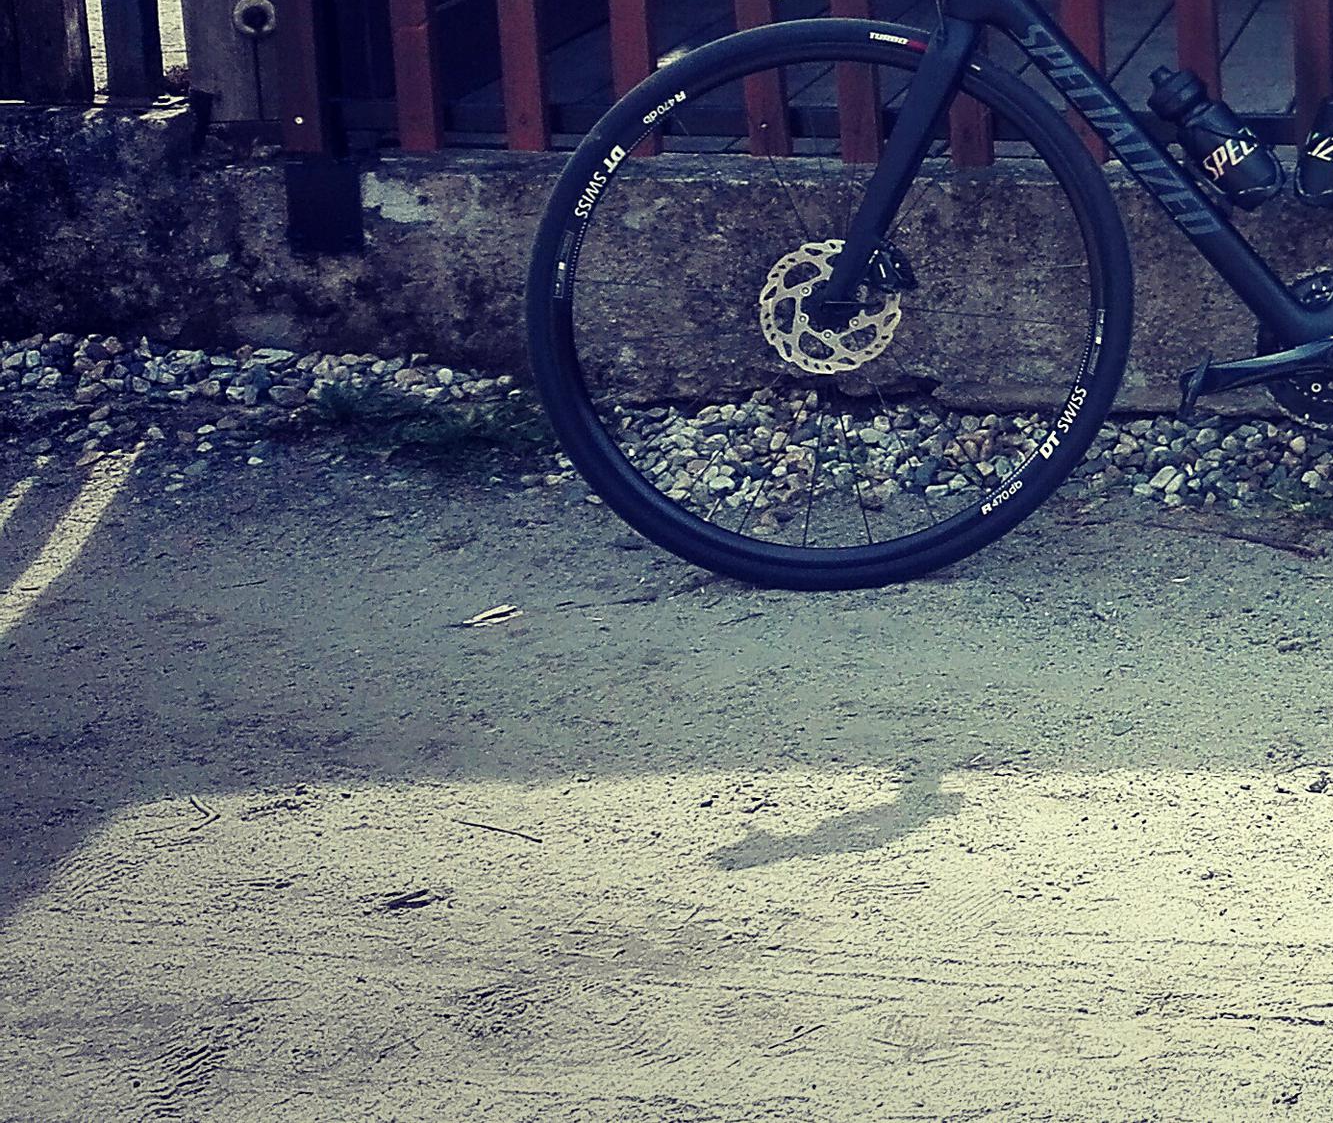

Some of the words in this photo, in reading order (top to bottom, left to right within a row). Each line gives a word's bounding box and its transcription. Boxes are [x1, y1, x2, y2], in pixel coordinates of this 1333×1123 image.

[603, 145, 626, 173] DT
[1019, 24, 1221, 234] SPECIALIZED
[574, 171, 606, 218] SWISS
[1039, 430, 1060, 459] DT
[1057, 385, 1087, 433] SWISS
